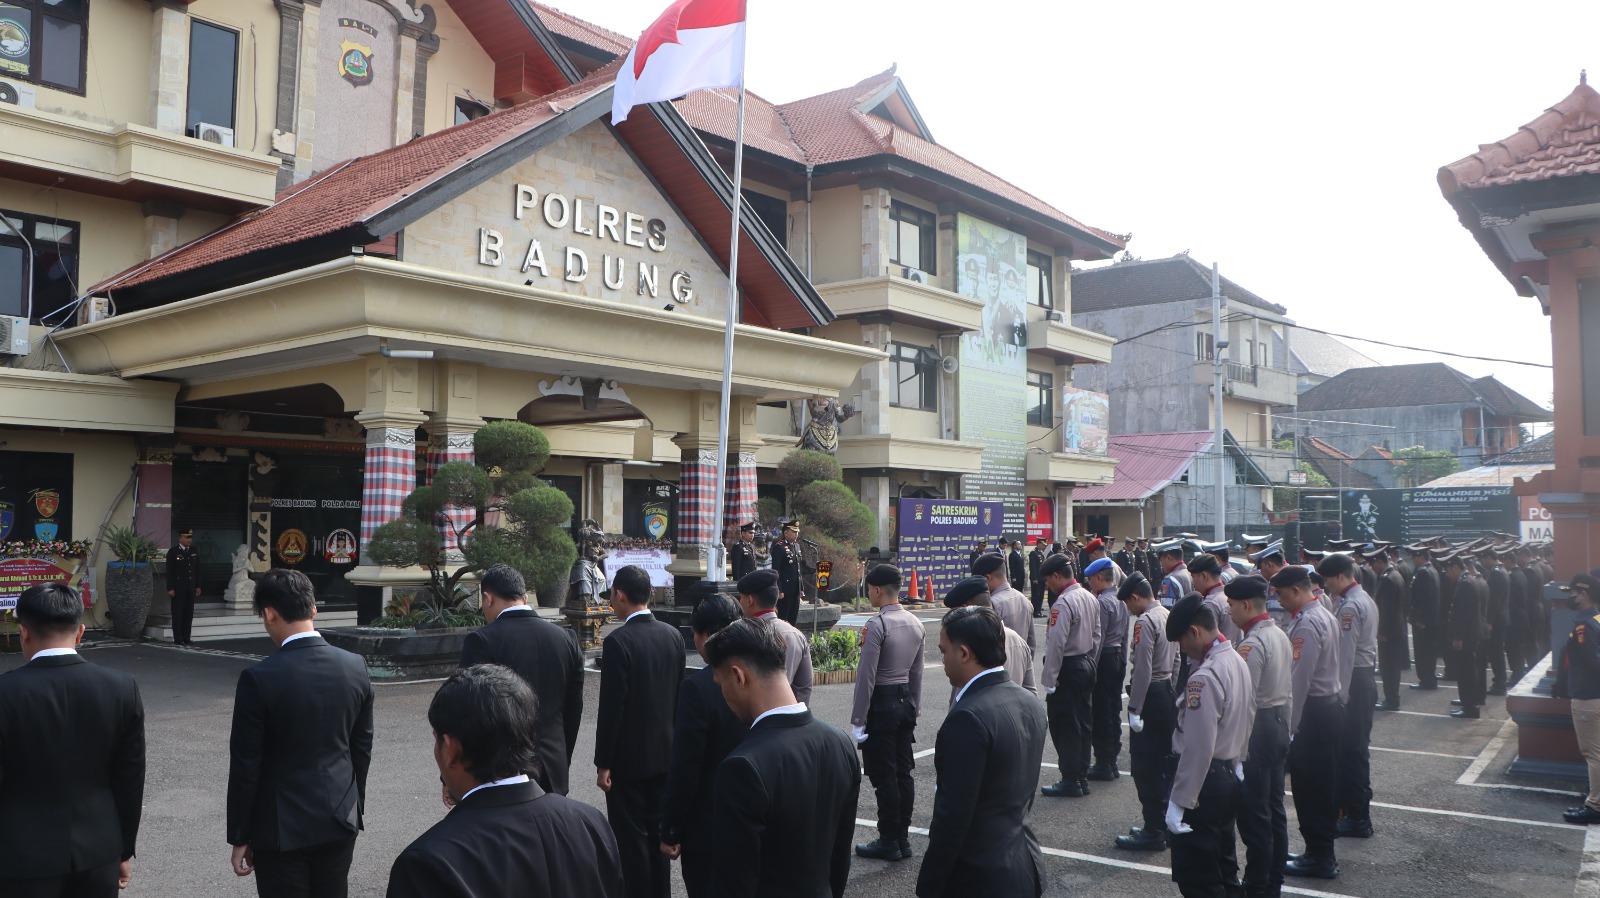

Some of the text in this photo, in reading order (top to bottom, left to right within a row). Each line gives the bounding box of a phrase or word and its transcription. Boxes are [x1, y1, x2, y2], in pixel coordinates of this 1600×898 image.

[343, 19, 374, 34] BALI
[514, 183, 667, 252] POLRES
[478, 227, 693, 304] BADUNG
[1413, 489, 1482, 497] COMMANDER
[270, 498, 361, 509] POLRES BADUNG POLDA BALI
[931, 505, 978, 516] SATRESKRIM
[930, 516, 978, 525] POLRES BADUNG
